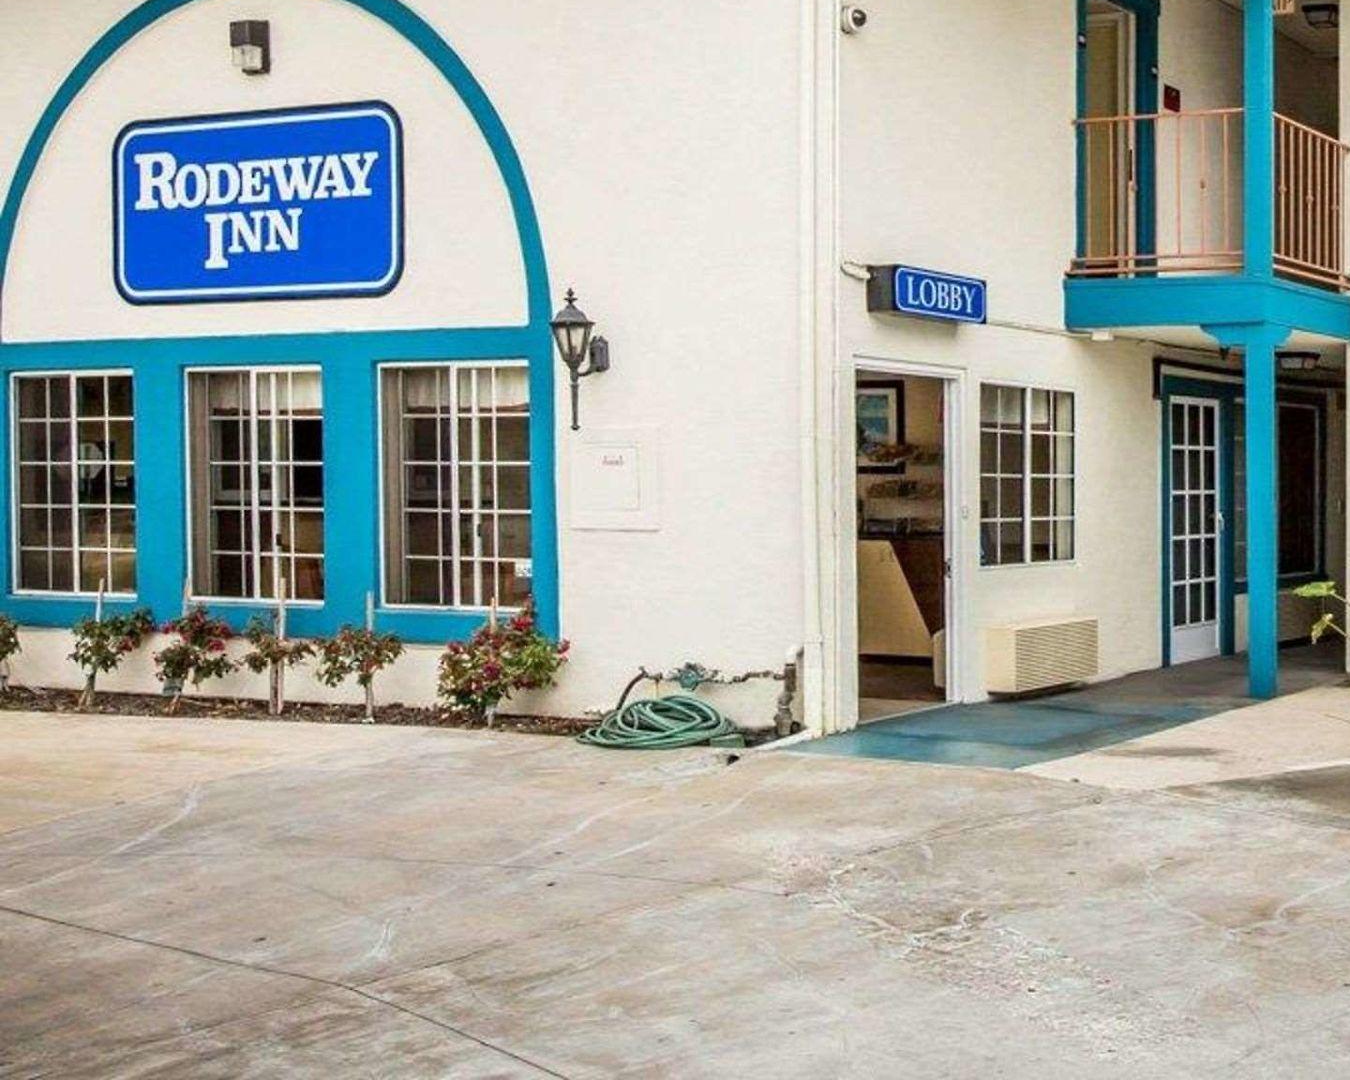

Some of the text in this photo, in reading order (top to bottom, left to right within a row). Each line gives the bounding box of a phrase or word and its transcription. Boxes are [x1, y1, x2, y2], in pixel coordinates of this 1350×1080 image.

[133, 151, 379, 211] RODEWAY
[203, 208, 302, 269] INN
[906, 274, 976, 314] LOBBY
